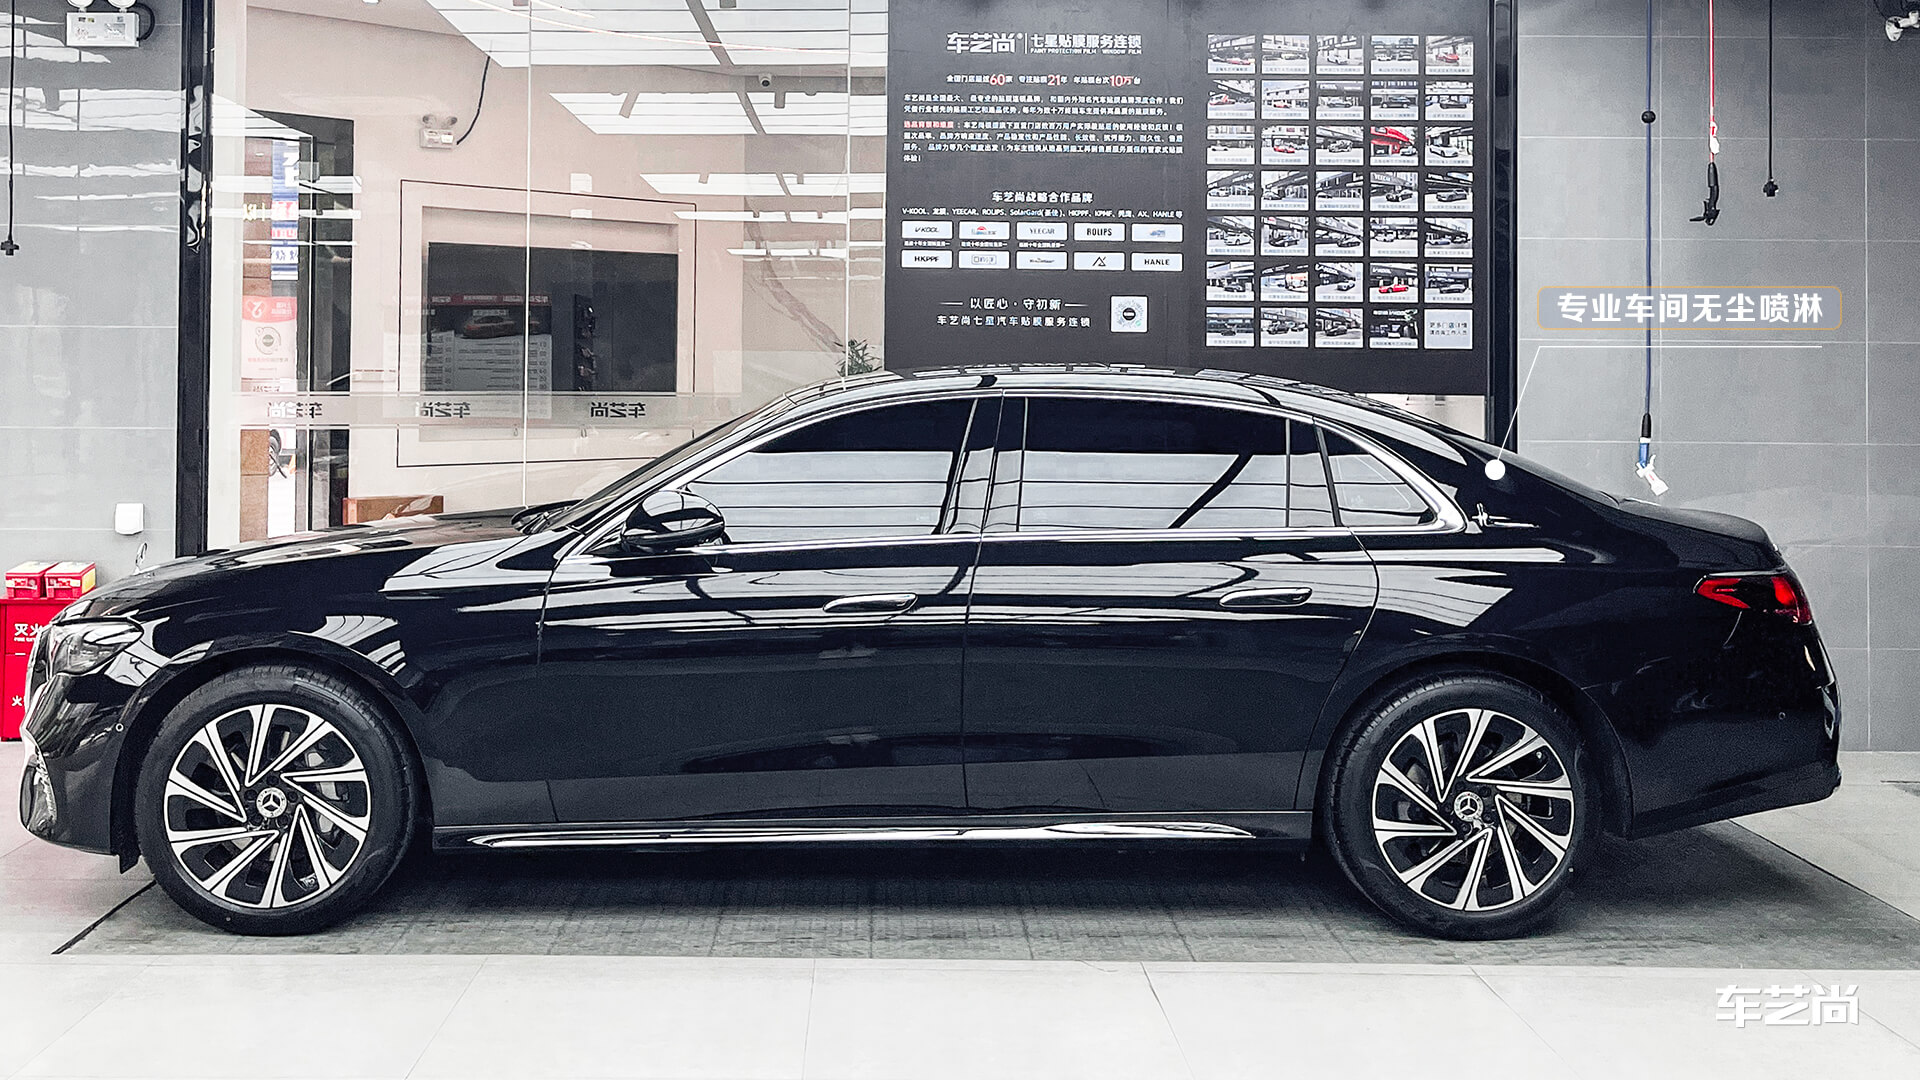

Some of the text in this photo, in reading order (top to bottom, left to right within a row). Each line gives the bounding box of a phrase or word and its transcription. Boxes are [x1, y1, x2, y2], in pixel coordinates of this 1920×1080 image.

[946, 33, 1016, 54] 车艺尚
[1030, 34, 1142, 49] 七星贴膜服务连锁
[992, 191, 1093, 203] 车艺尚战略合作品牌
[1086, 228, 1112, 236] ROLIPS
[937, 315, 1091, 328] 车艺尚七星汽车贴膜服务连锁
